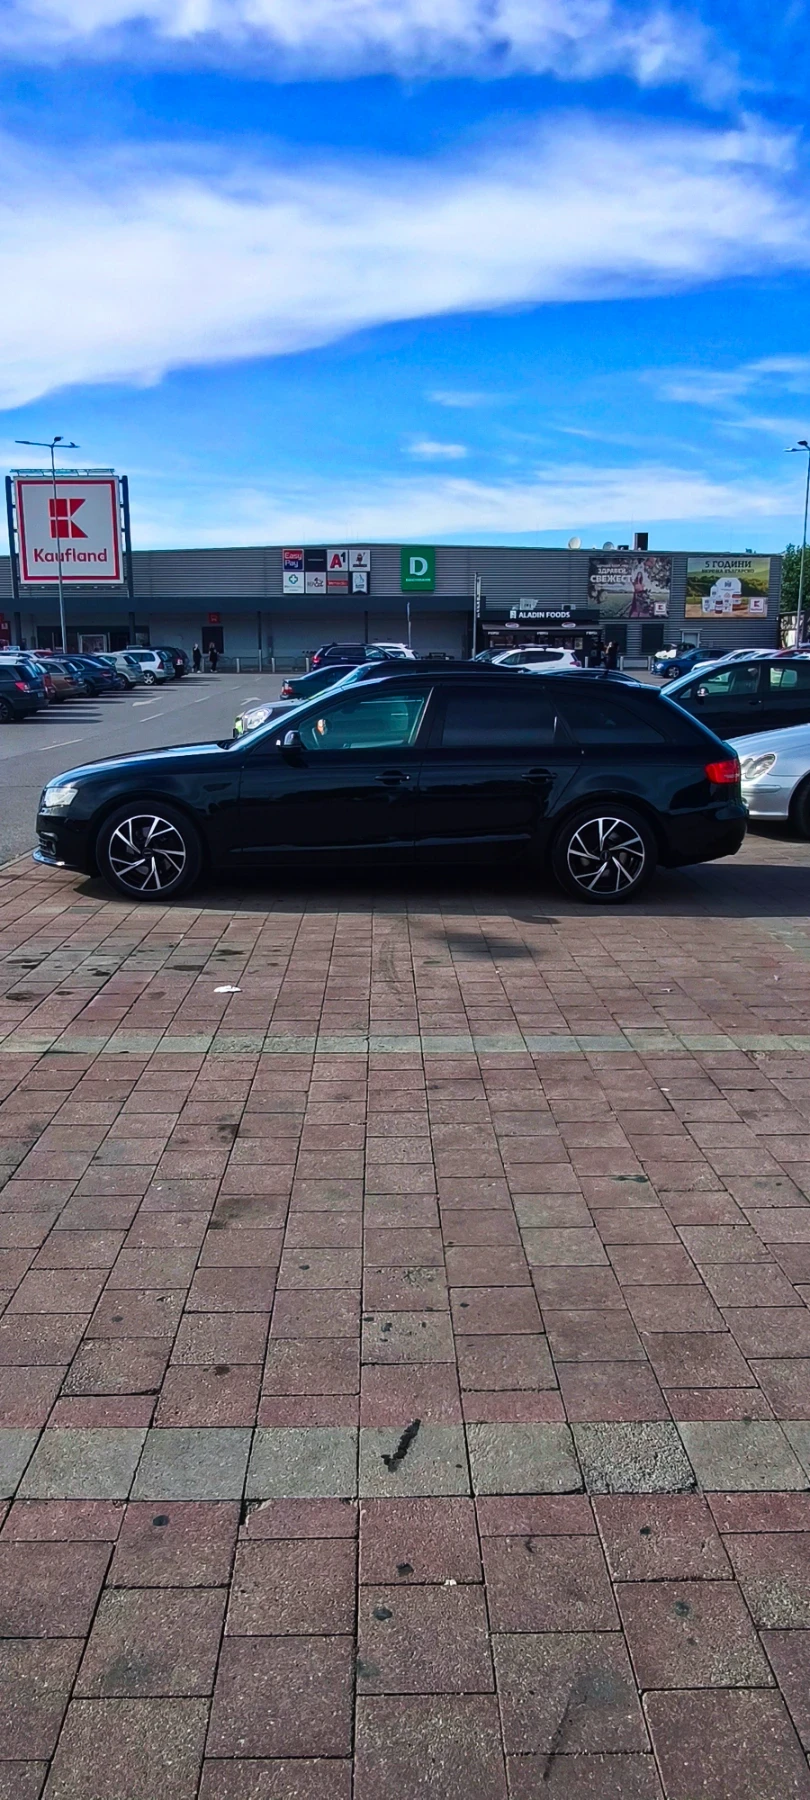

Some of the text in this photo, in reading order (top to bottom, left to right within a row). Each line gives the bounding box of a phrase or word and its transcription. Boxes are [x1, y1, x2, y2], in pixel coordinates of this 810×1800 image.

[33, 548, 108, 562] Kaufland
[284, 551, 303, 561] Easy
[329, 551, 346, 569] A1
[284, 559, 299, 568] Pay
[409, 556, 429, 576] D
[704, 560, 752, 569] 5 ГОДИНИ
